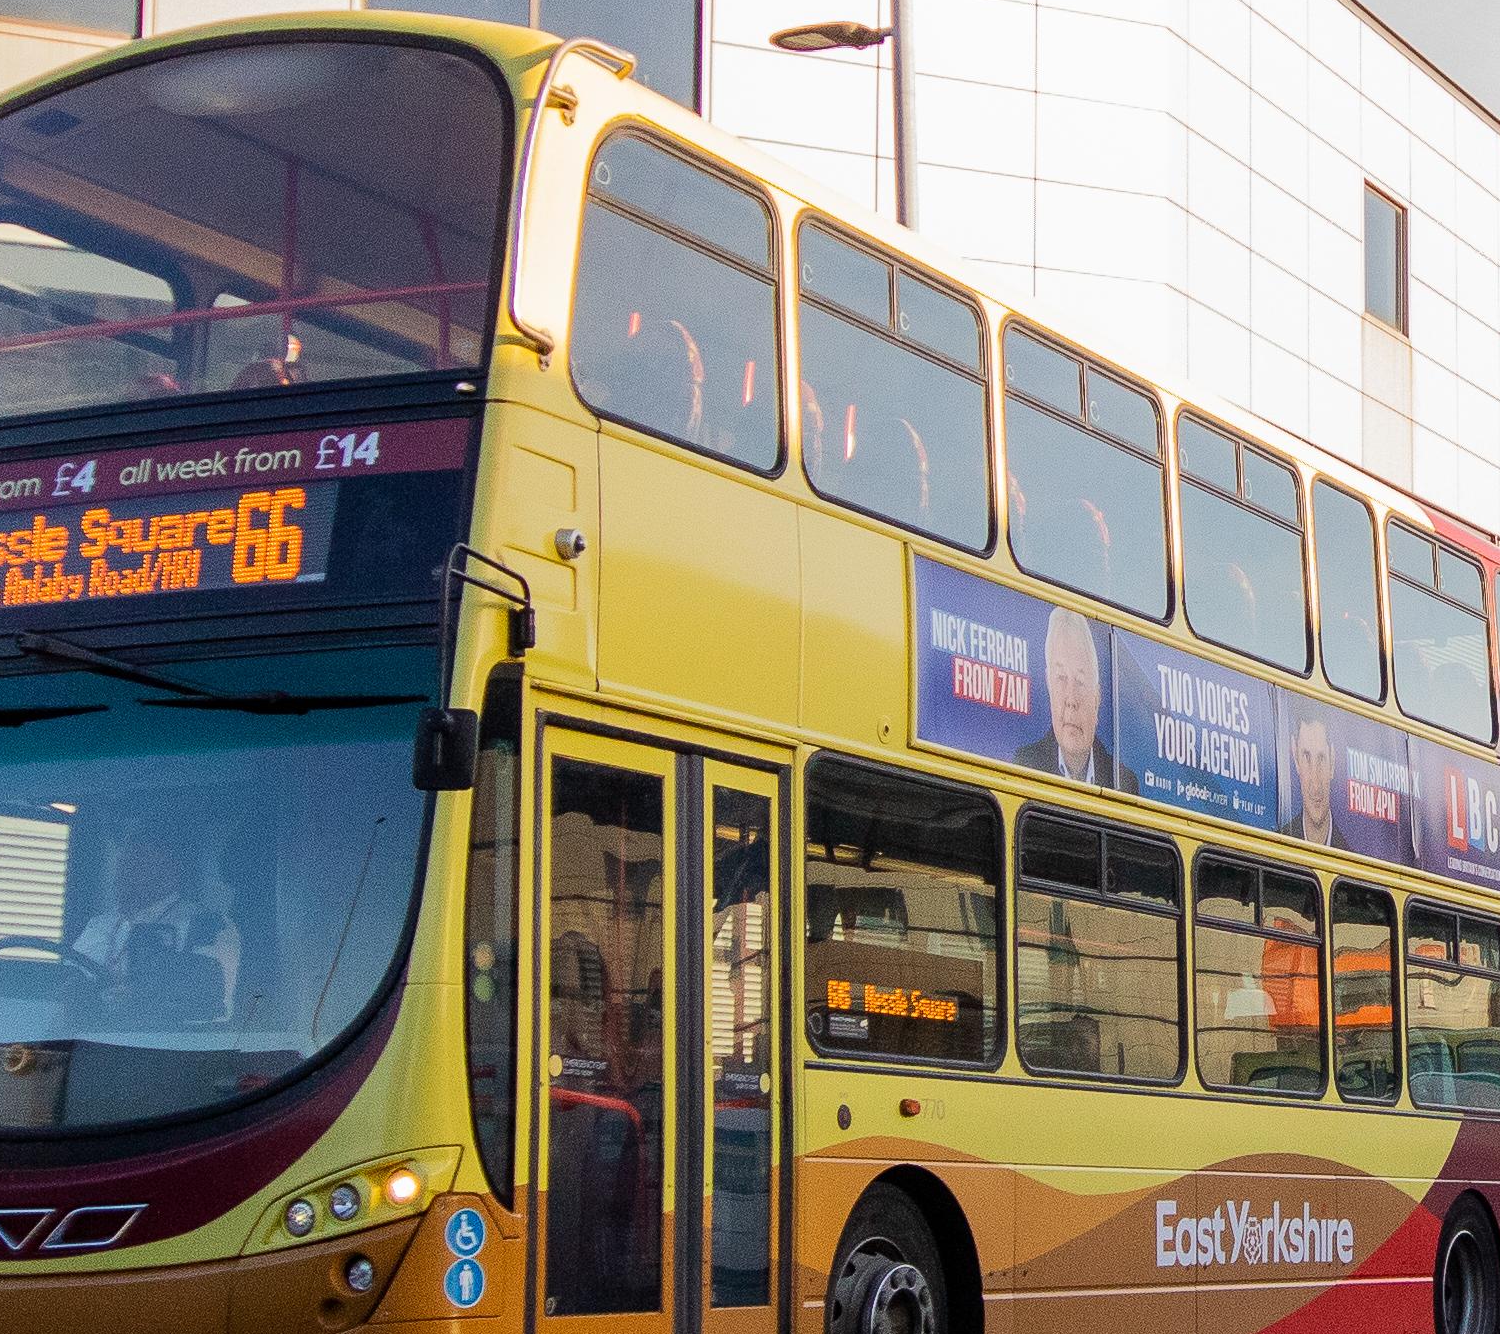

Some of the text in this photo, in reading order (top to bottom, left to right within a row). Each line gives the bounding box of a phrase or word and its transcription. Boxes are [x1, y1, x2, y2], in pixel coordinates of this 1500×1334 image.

[51, 460, 99, 496] £4
[120, 458, 153, 485] all
[156, 451, 227, 481] week
[233, 447, 301, 473] from
[315, 431, 380, 469] £14
[80, 507, 236, 558] Square
[232, 487, 307, 584] 66
[3, 562, 85, 606] Anlaby
[932, 608, 1029, 675] NICK FERRARI
[954, 656, 1029, 714] FROM 7AM
[1158, 664, 1250, 735] TWO VOICES
[1154, 713, 1261, 786] YOUR AGENDA
[1348, 748, 1421, 799] TOM SWARBRIK
[1350, 782, 1396, 822] FROM 4PM
[1450, 775, 1499, 854] LBC
[1156, 1200, 1226, 1267] East
